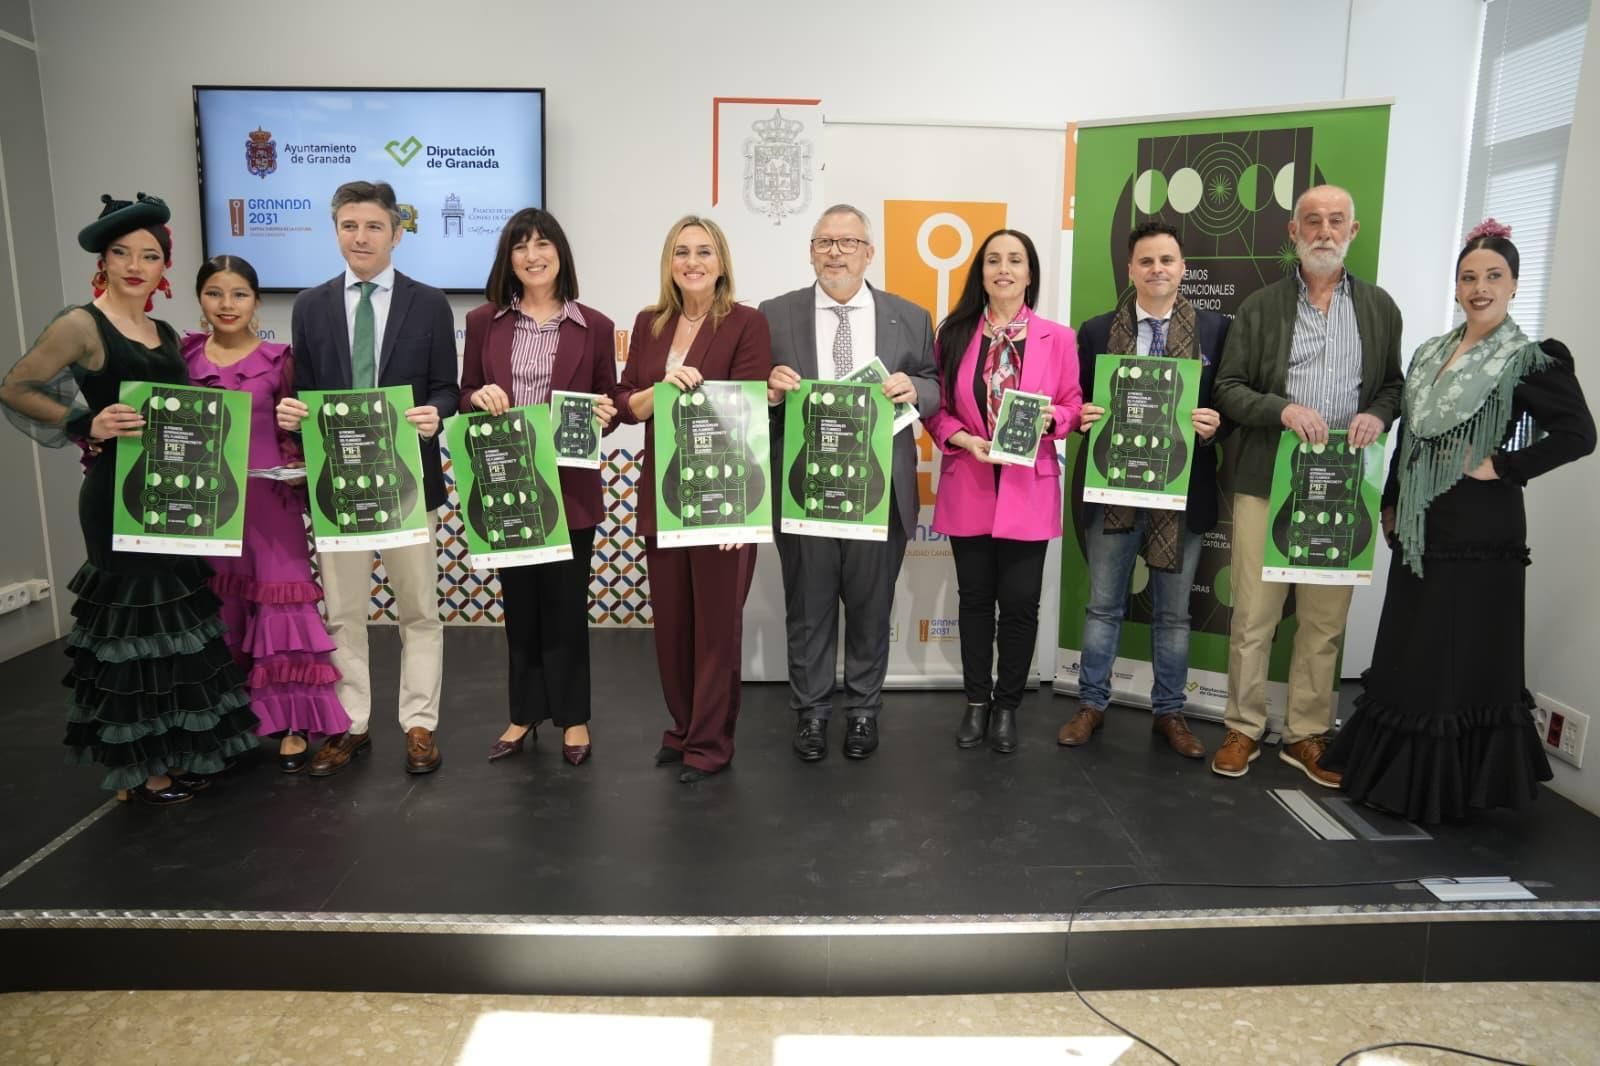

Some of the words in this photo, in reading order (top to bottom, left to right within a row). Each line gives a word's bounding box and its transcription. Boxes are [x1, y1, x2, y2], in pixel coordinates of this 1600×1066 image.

[284, 143, 357, 155] Ayuntamiento
[426, 145, 495, 158] Diputación
[290, 154, 304, 164] de
[306, 154, 352, 164] Granada
[426, 158, 442, 168] de
[445, 158, 500, 168] Granada
[248, 199, 312, 210] GRANADA
[249, 213, 278, 225] 2031
[1184, 269, 1208, 280] EMIOS
[1178, 284, 1235, 295] ERNACIONALES
